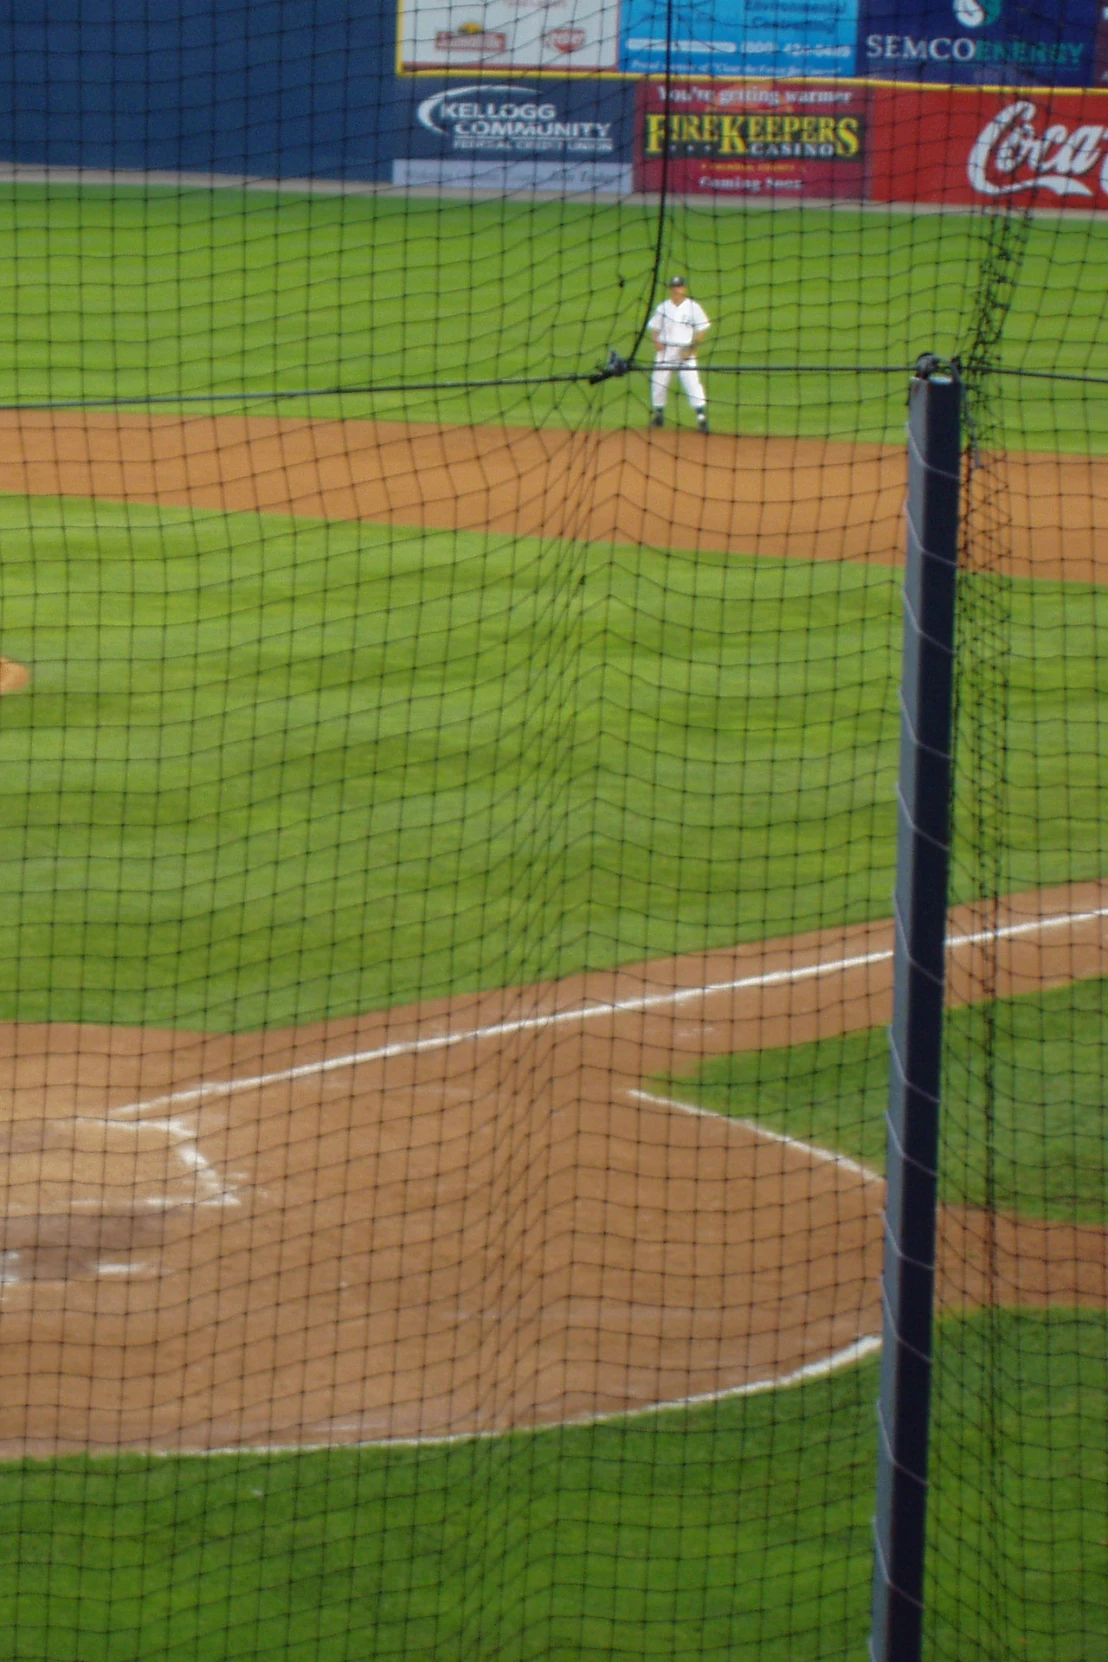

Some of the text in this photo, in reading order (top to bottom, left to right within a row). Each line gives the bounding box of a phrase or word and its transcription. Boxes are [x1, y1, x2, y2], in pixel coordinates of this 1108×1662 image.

[867, 34, 976, 61] SEMCO
[658, 86, 854, 107] You're getting warmer
[443, 102, 557, 120] KELLOGG
[453, 121, 612, 137] COMMUNITY
[750, 142, 835, 157] CASINO
[698, 176, 762, 191] Coming
